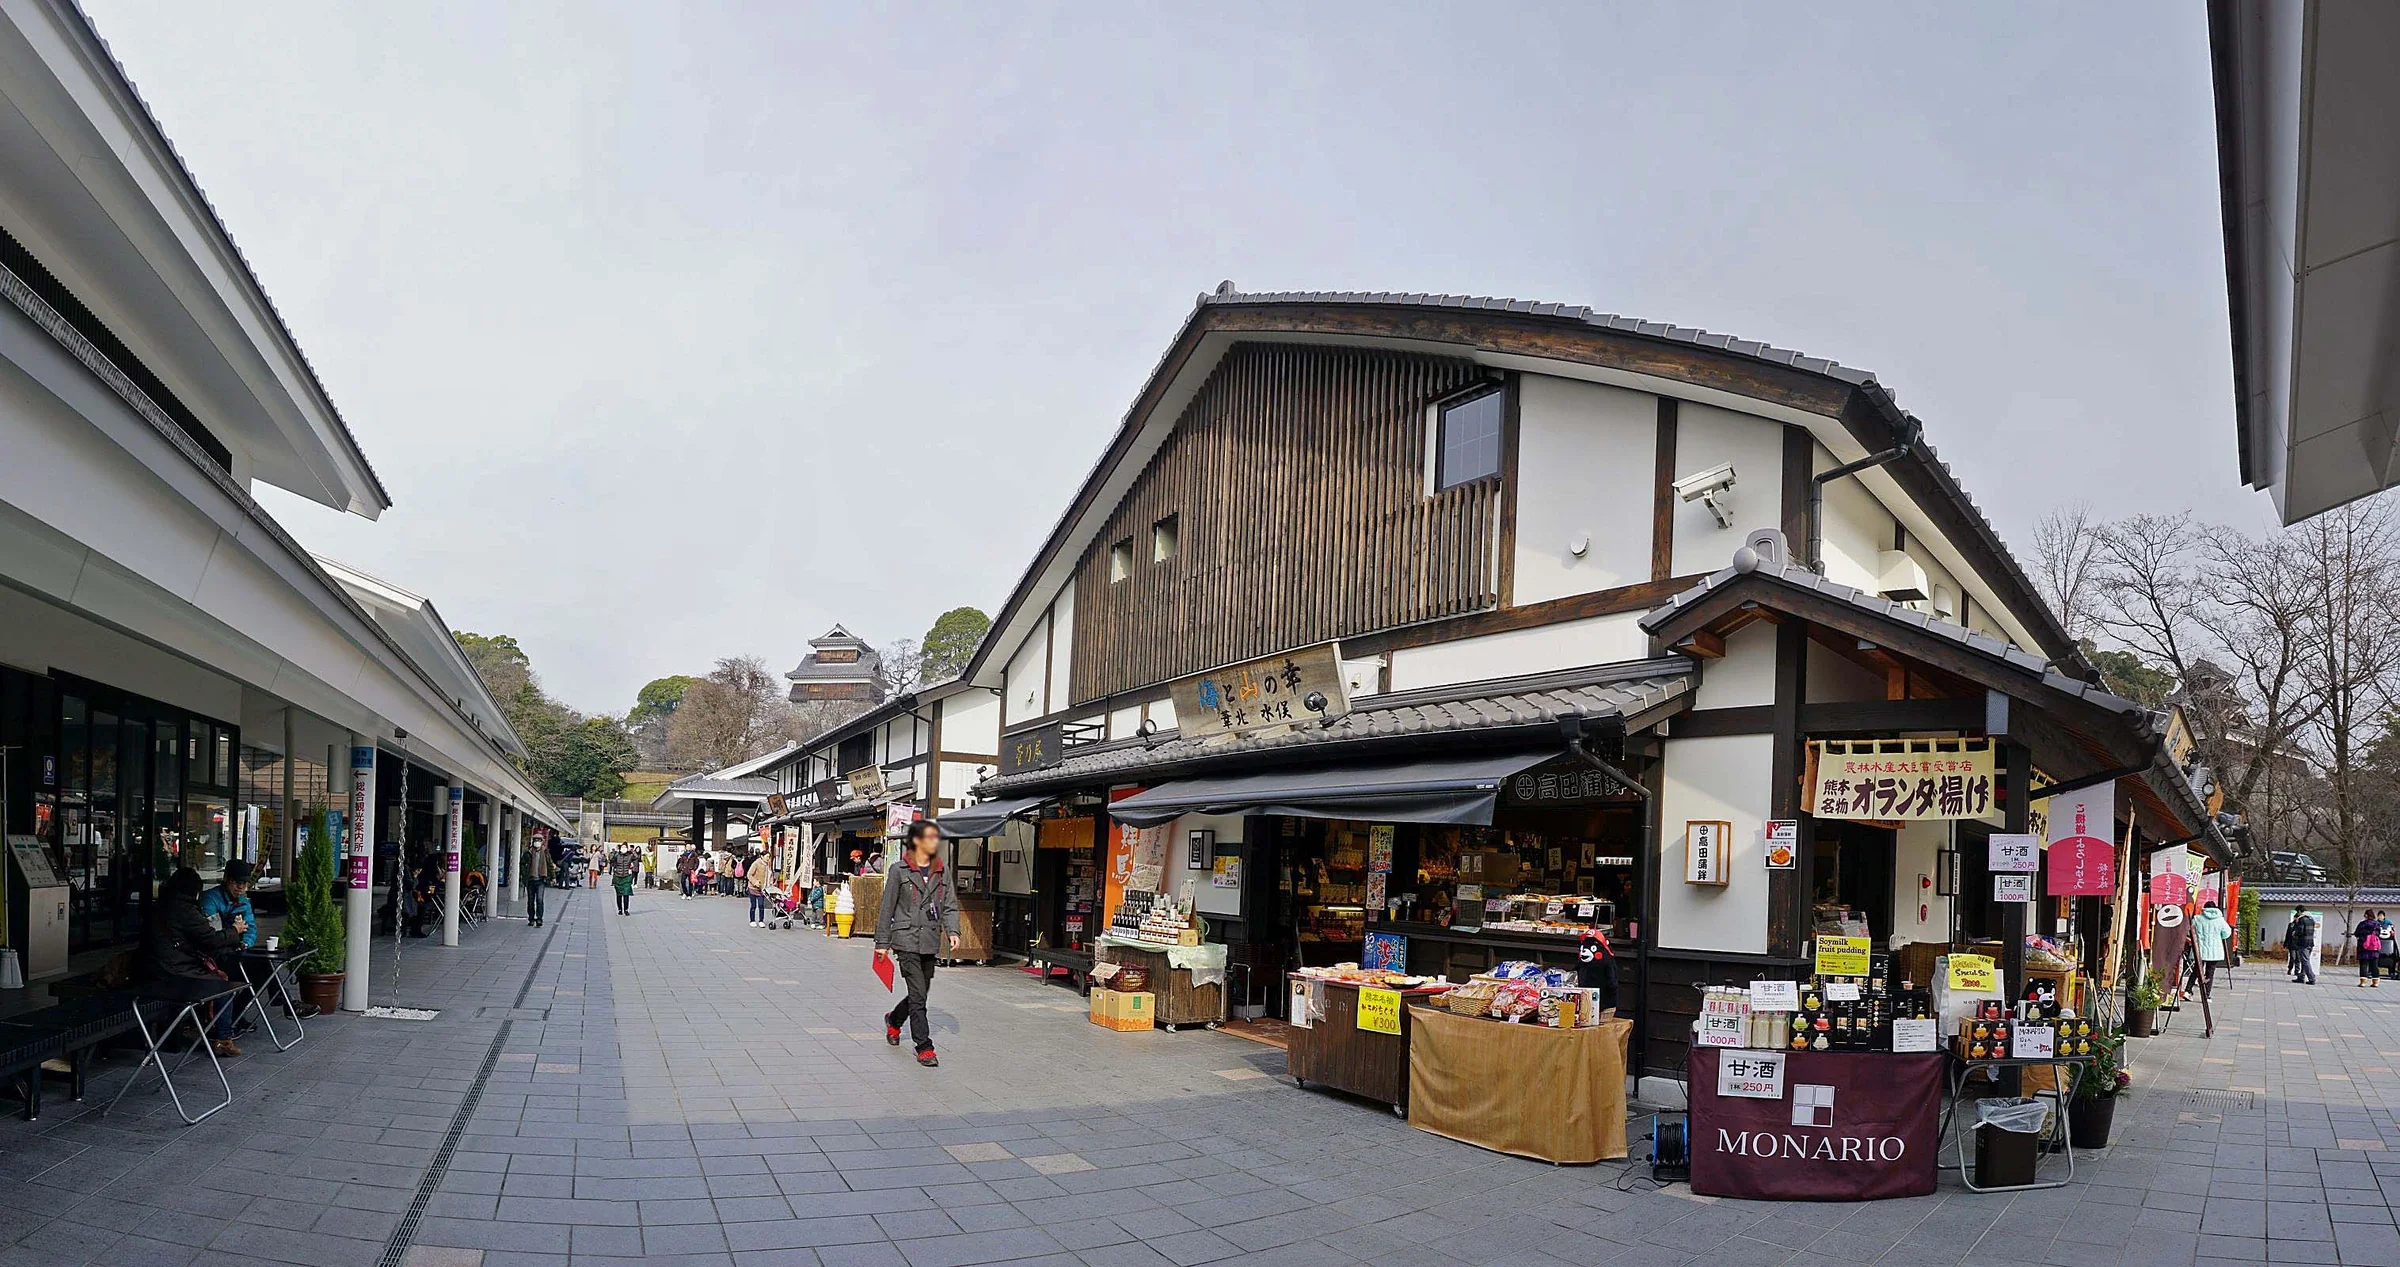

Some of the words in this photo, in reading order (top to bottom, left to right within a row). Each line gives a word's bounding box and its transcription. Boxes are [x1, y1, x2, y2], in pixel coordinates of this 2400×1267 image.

[1197, 659, 1301, 710] 海と山の幸
[1260, 701, 1293, 723] 水俣
[1844, 760, 1973, 774] 農林水産大臣賞受賞店
[1822, 779, 1851, 797] 熊本
[1852, 775, 1989, 817] オランダ揚げ
[1820, 798, 1850, 815] 名物
[354, 781, 365, 852] 総合観光案内所
[2001, 845, 2029, 857] 甘酒
[2013, 861, 2035, 869] 250円
[2002, 879, 2023, 888] 甘酒
[2000, 893, 2024, 901] 1000円
[1819, 937, 1849, 946] Soymilk
[1819, 945, 1836, 953] fruit
[1836, 946, 1867, 955] pudding
[1761, 983, 1786, 992] 甘酒
[1373, 1016, 1396, 1030] ¥300
[1709, 1018, 1736, 1030] 甘酒
[1706, 1035, 1737, 1045] 1000円
[1728, 1059, 1777, 1079] 甘酒
[1742, 1082, 1774, 1092] 250円
[1716, 1128, 1905, 1162] MONARIO
